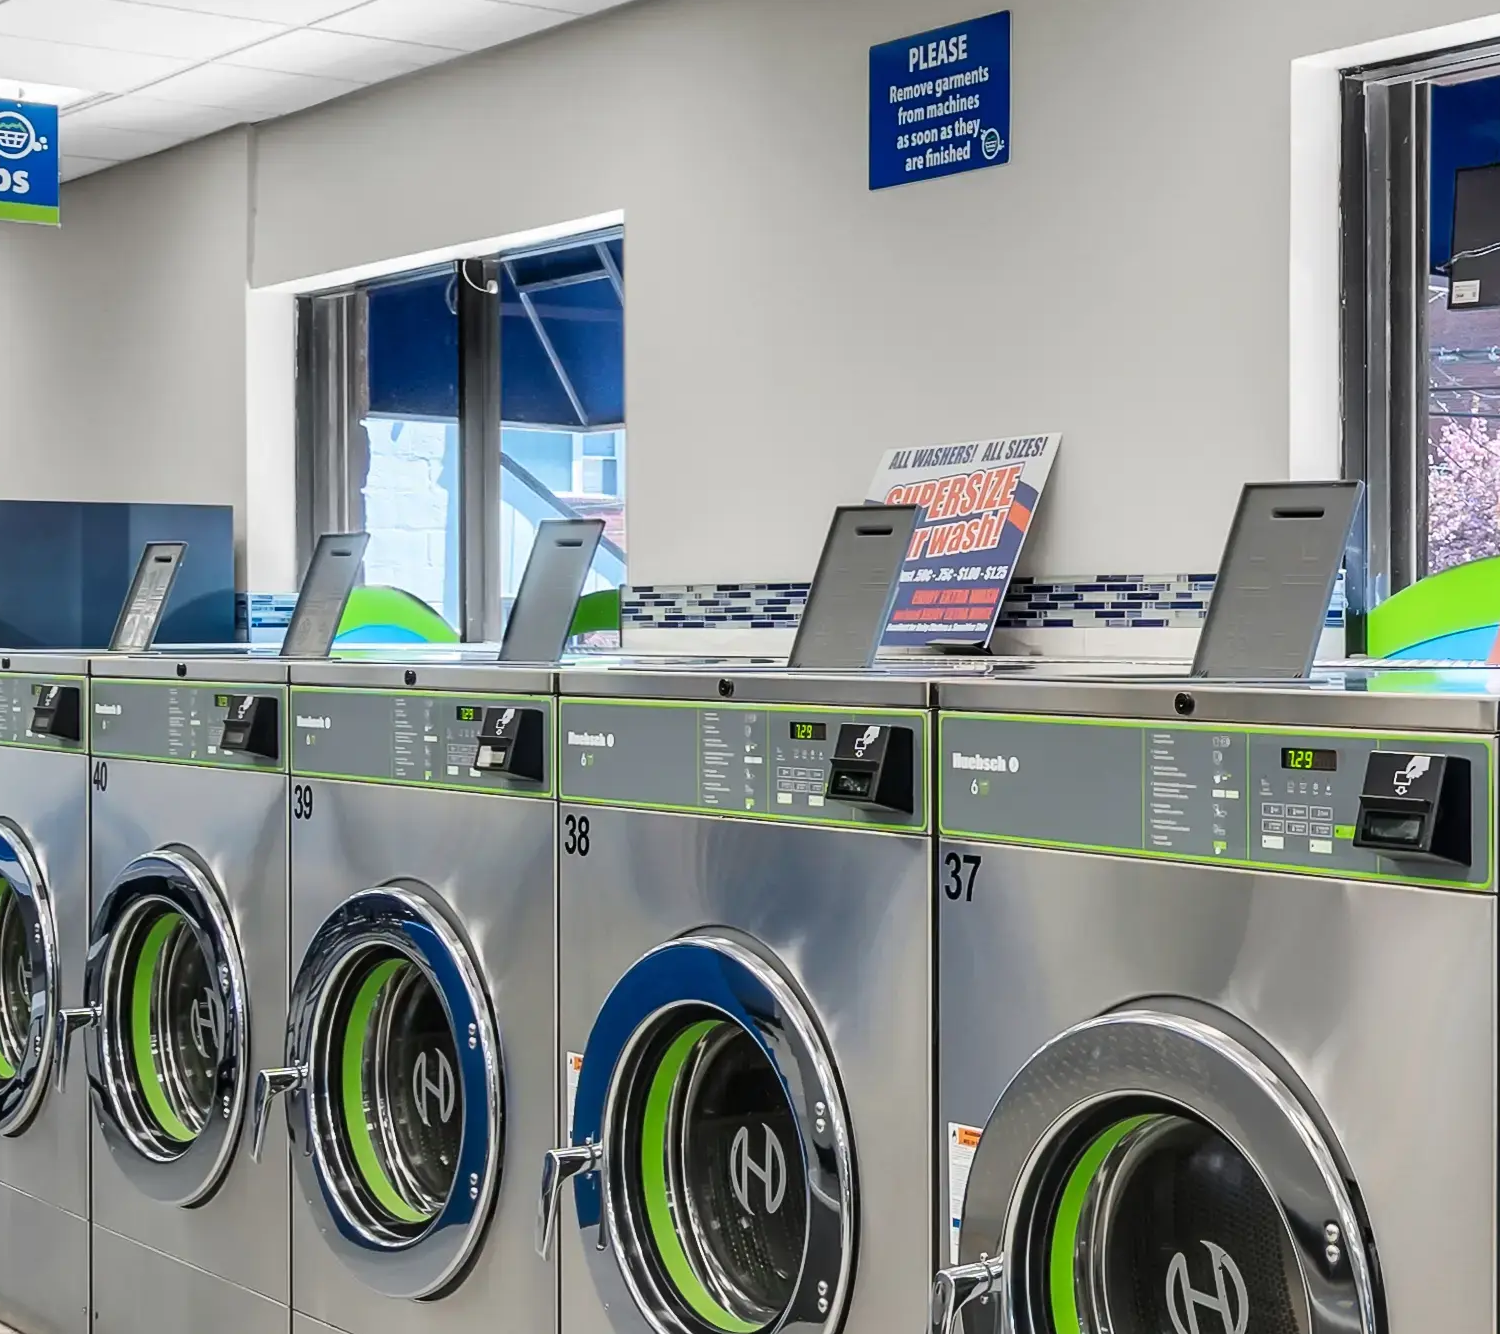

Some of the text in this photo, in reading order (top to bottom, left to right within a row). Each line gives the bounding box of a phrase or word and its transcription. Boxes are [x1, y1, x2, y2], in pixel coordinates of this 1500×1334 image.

[909, 34, 968, 72] PLEASE
[889, 66, 989, 103] Remove garments
[898, 94, 980, 125] from machines
[896, 117, 981, 150] as soon as they
[905, 140, 971, 172] are finished
[888, 436, 1048, 470] ALL WASHERS! ALL SIZES!
[885, 463, 1025, 521] SUPERSIZE
[926, 508, 1009, 558] wash!
[93, 761, 108, 792] 40
[970, 778, 979, 795] 6
[294, 784, 313, 820] 39
[564, 814, 590, 856] 38
[944, 852, 982, 902] 37
